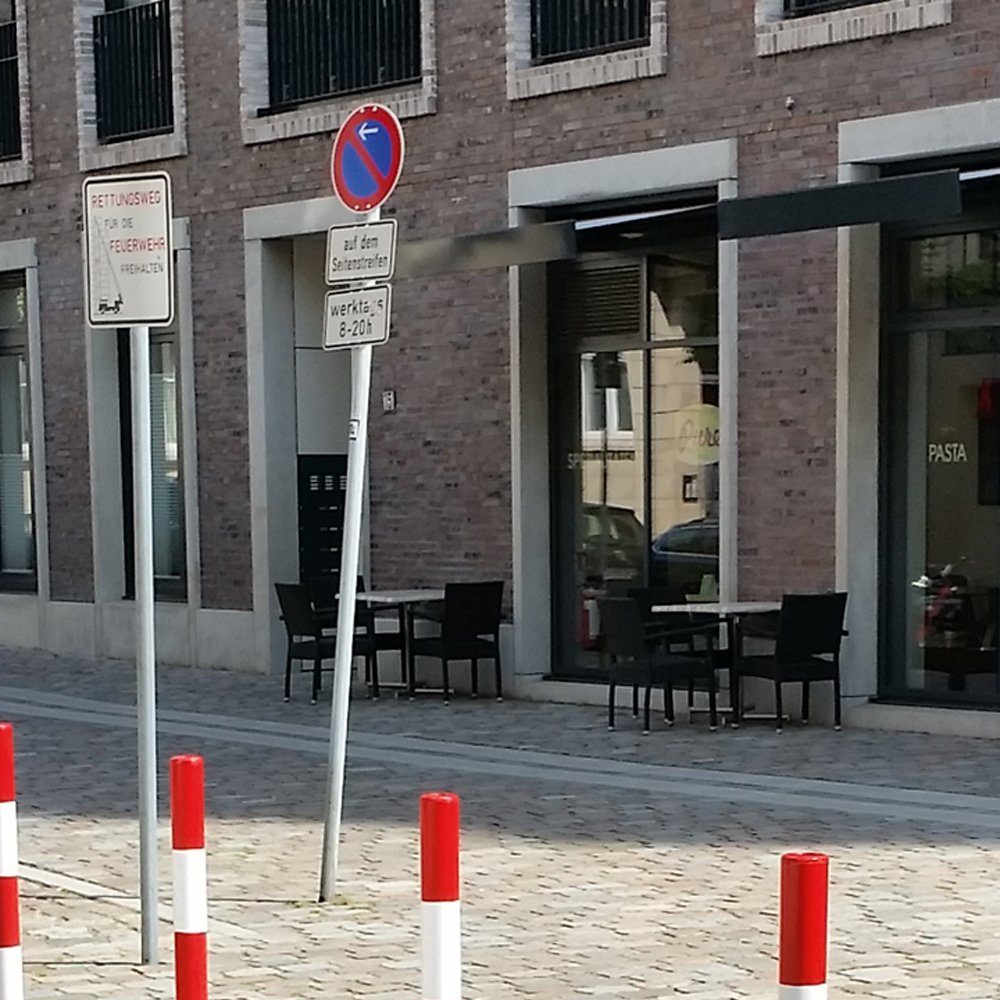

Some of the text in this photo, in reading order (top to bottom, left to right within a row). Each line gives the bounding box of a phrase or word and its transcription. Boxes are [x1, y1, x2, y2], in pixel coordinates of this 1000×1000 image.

[92, 190, 161, 208] RETTUNGSWEG
[121, 217, 134, 229] DIE
[110, 237, 166, 253] FEUERWEHR
[344, 234, 378, 251] auf dem
[121, 262, 164, 275] FREIHALTEN
[332, 253, 388, 272] Seitenstreifen
[928, 443, 968, 462] PASTA
